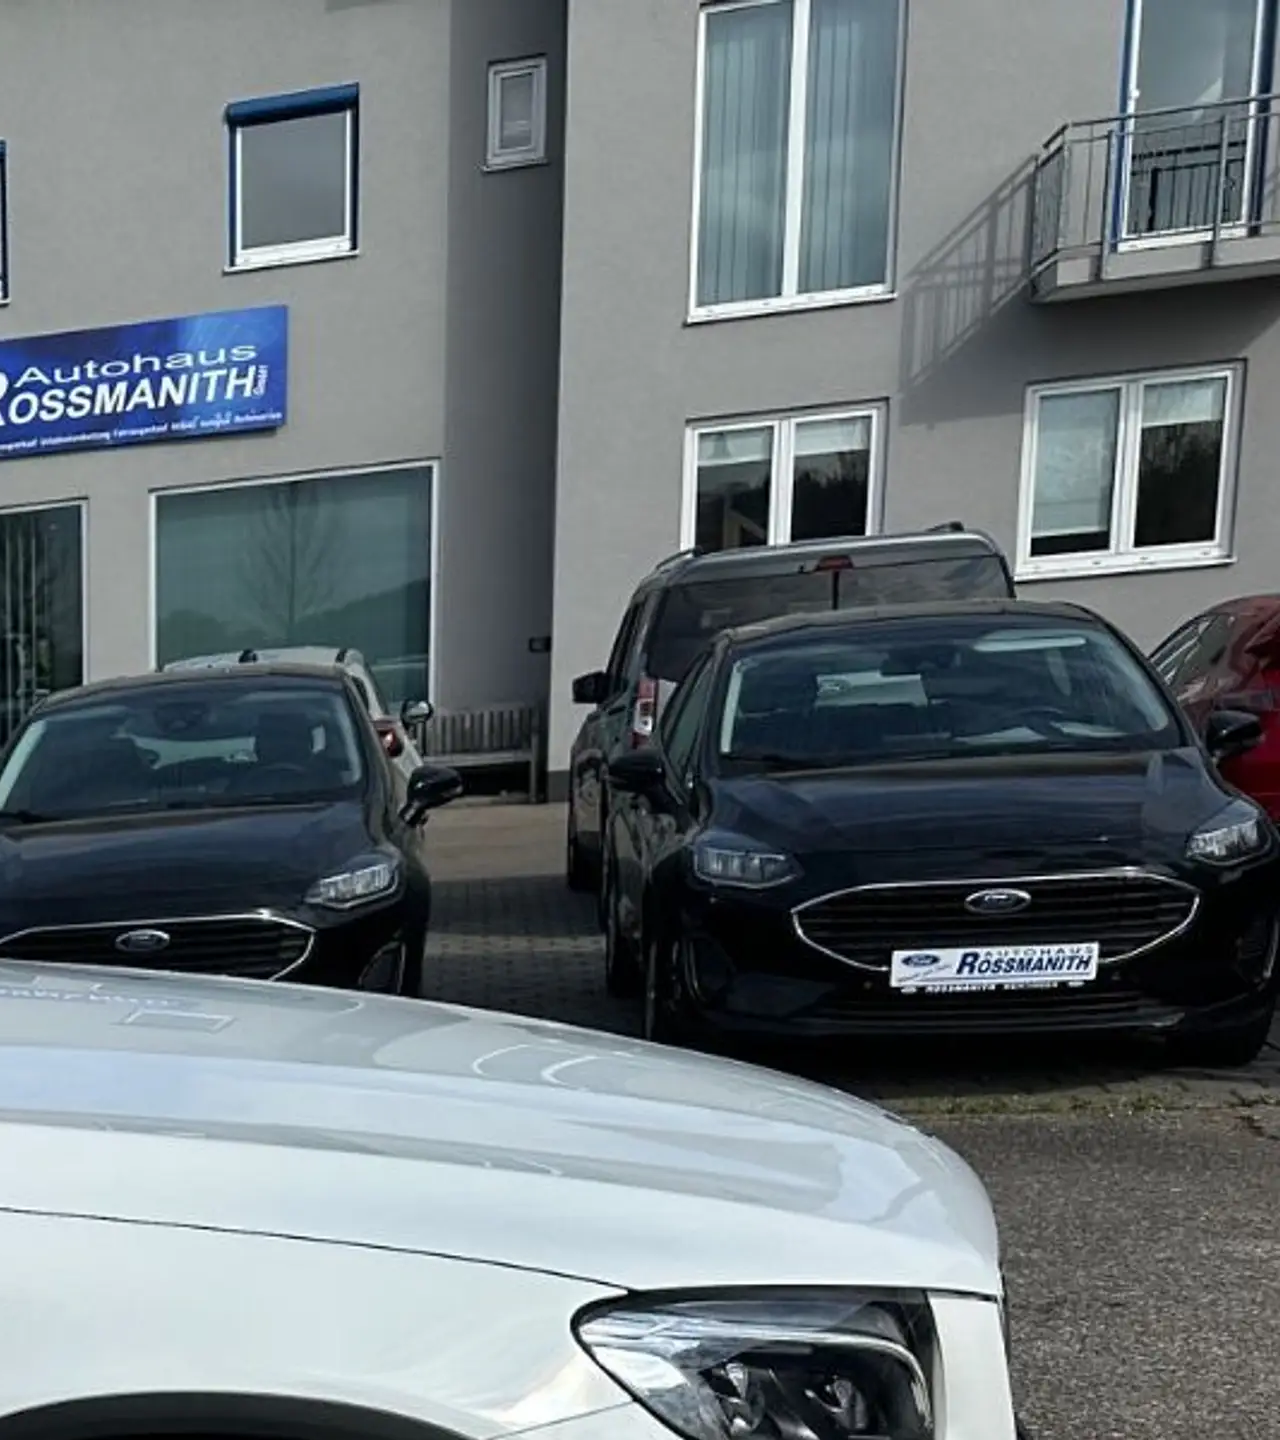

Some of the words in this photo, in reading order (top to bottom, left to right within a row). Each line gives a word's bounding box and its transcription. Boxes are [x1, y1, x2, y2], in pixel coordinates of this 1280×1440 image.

[14, 345, 257, 388] Autohaus
[985, 946, 1094, 957] AUTOHAUS
[956, 952, 1091, 975] ROSSMANITH
